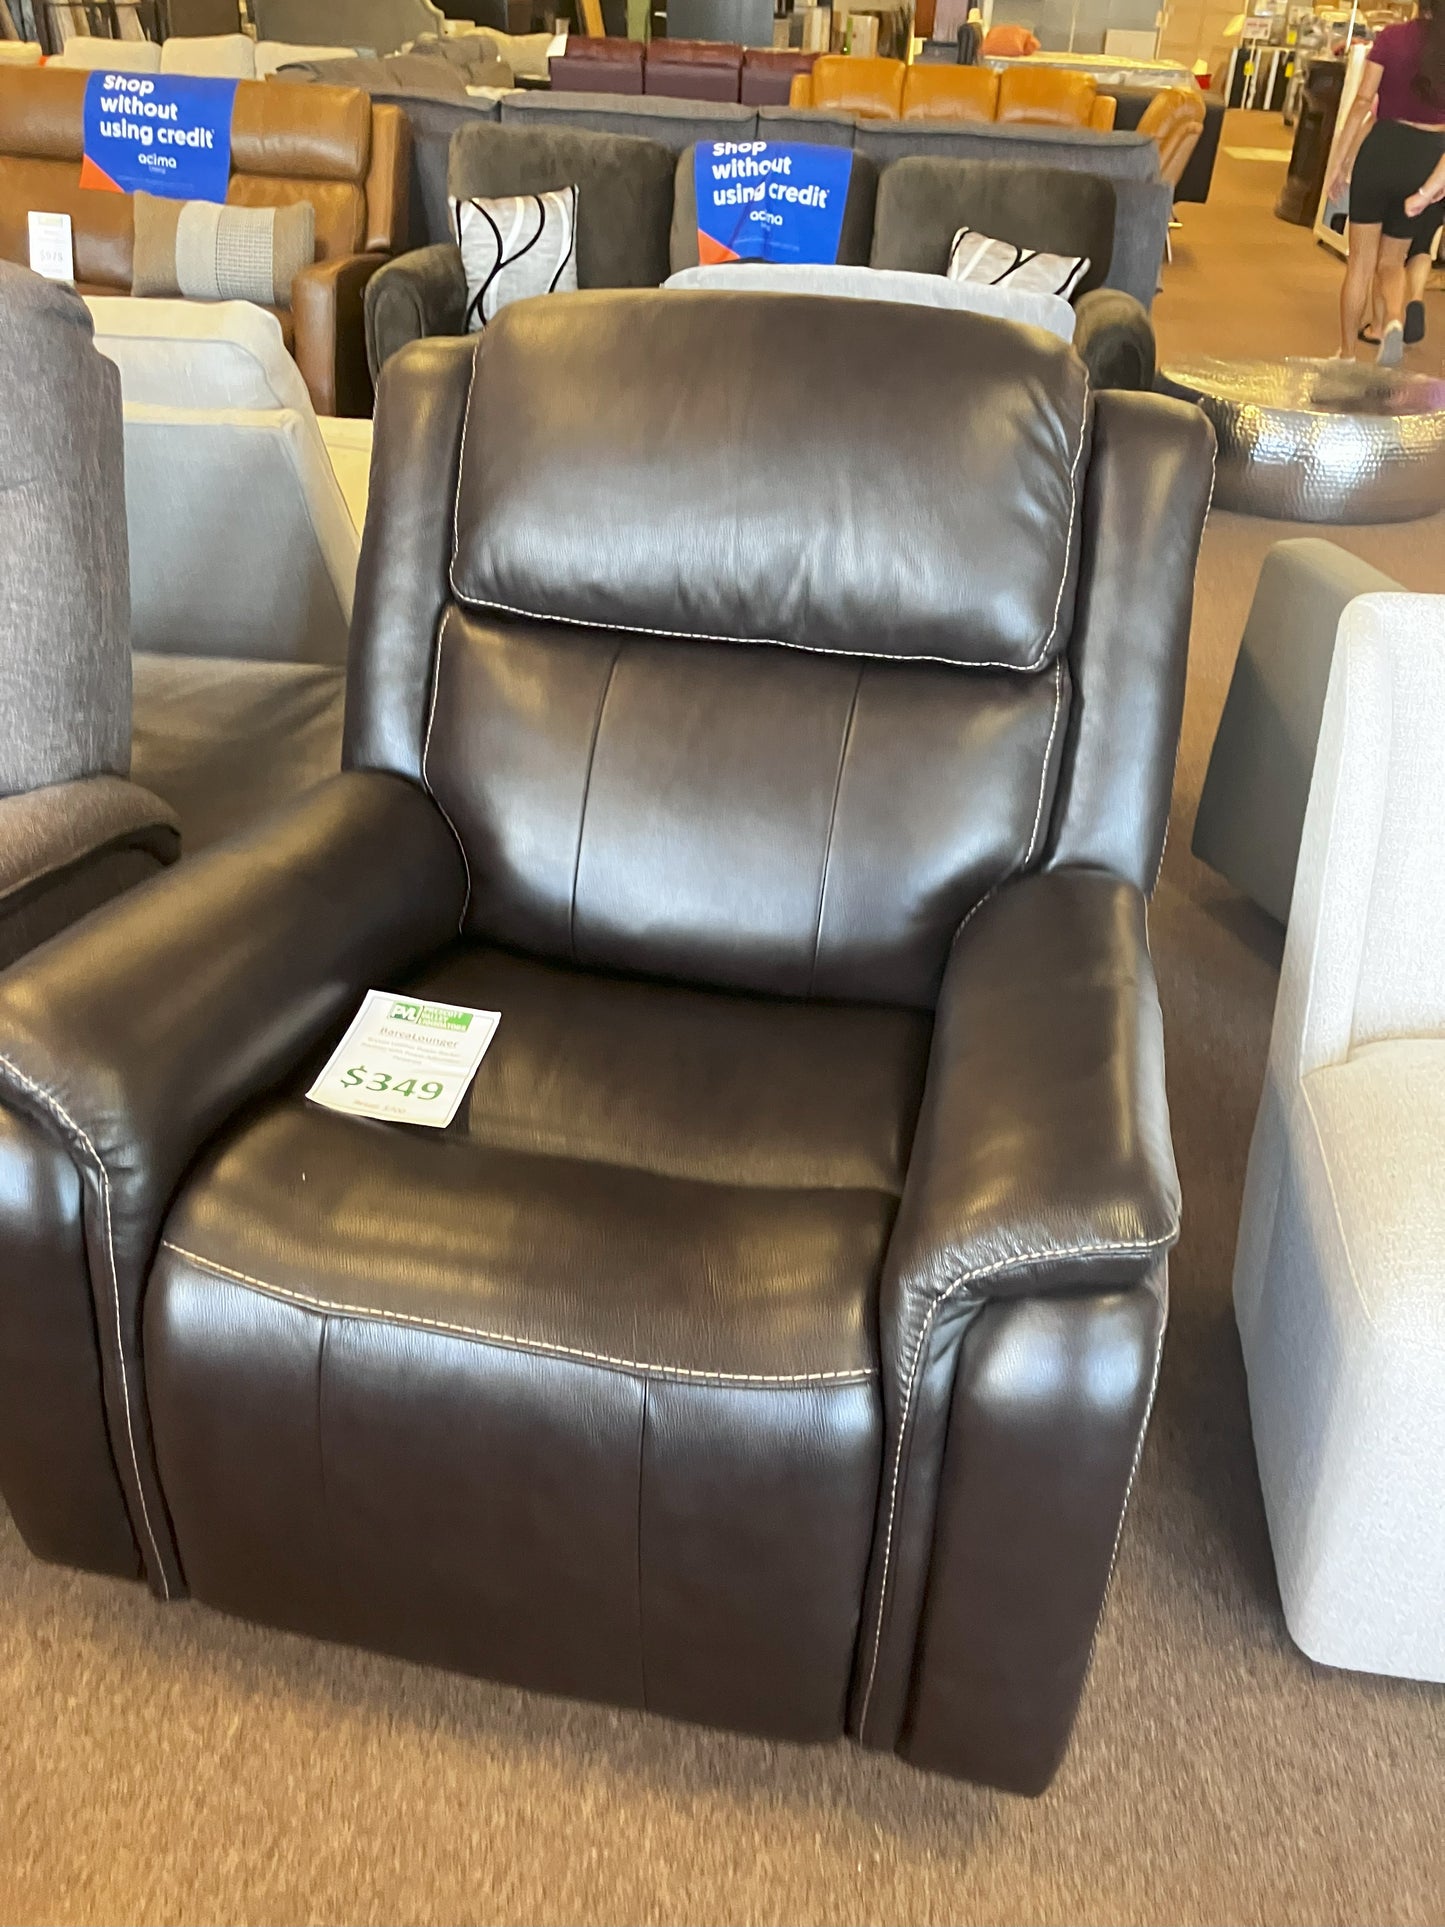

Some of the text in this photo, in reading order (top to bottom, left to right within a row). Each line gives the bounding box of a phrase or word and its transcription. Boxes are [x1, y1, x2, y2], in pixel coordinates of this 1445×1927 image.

[100, 94, 178, 121] without
[99, 118, 154, 146] using
[137, 152, 177, 169] acima
[711, 156, 792, 180] without
[713, 181, 766, 206] using
[749, 209, 783, 225] acma
[390, 1004, 417, 1021] PVL
[340, 1064, 444, 1100] $349
